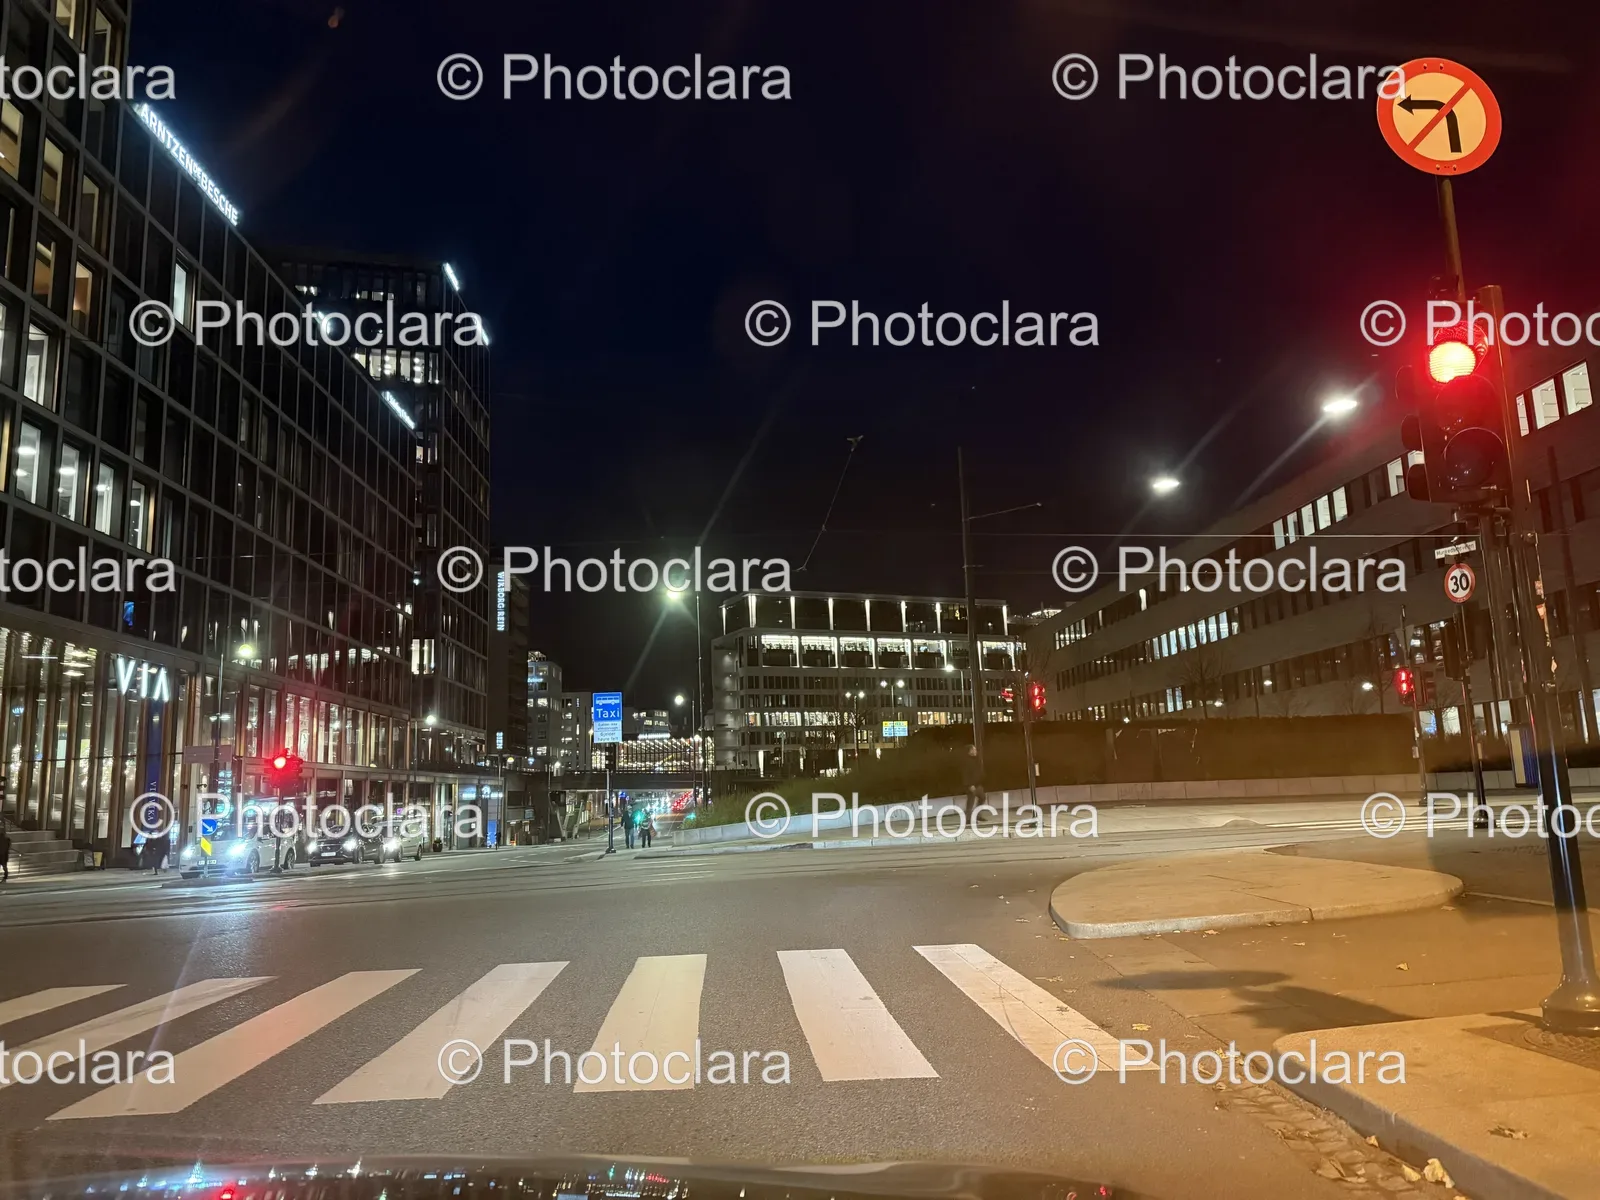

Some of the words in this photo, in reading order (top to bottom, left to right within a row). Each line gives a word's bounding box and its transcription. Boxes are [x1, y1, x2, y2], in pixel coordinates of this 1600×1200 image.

[140, 102, 194, 176] ARNTZEN
[200, 173, 239, 227] BESCHE
[1449, 572, 1470, 594] 30
[117, 657, 169, 703] VIA
[596, 708, 620, 719] Taxi
